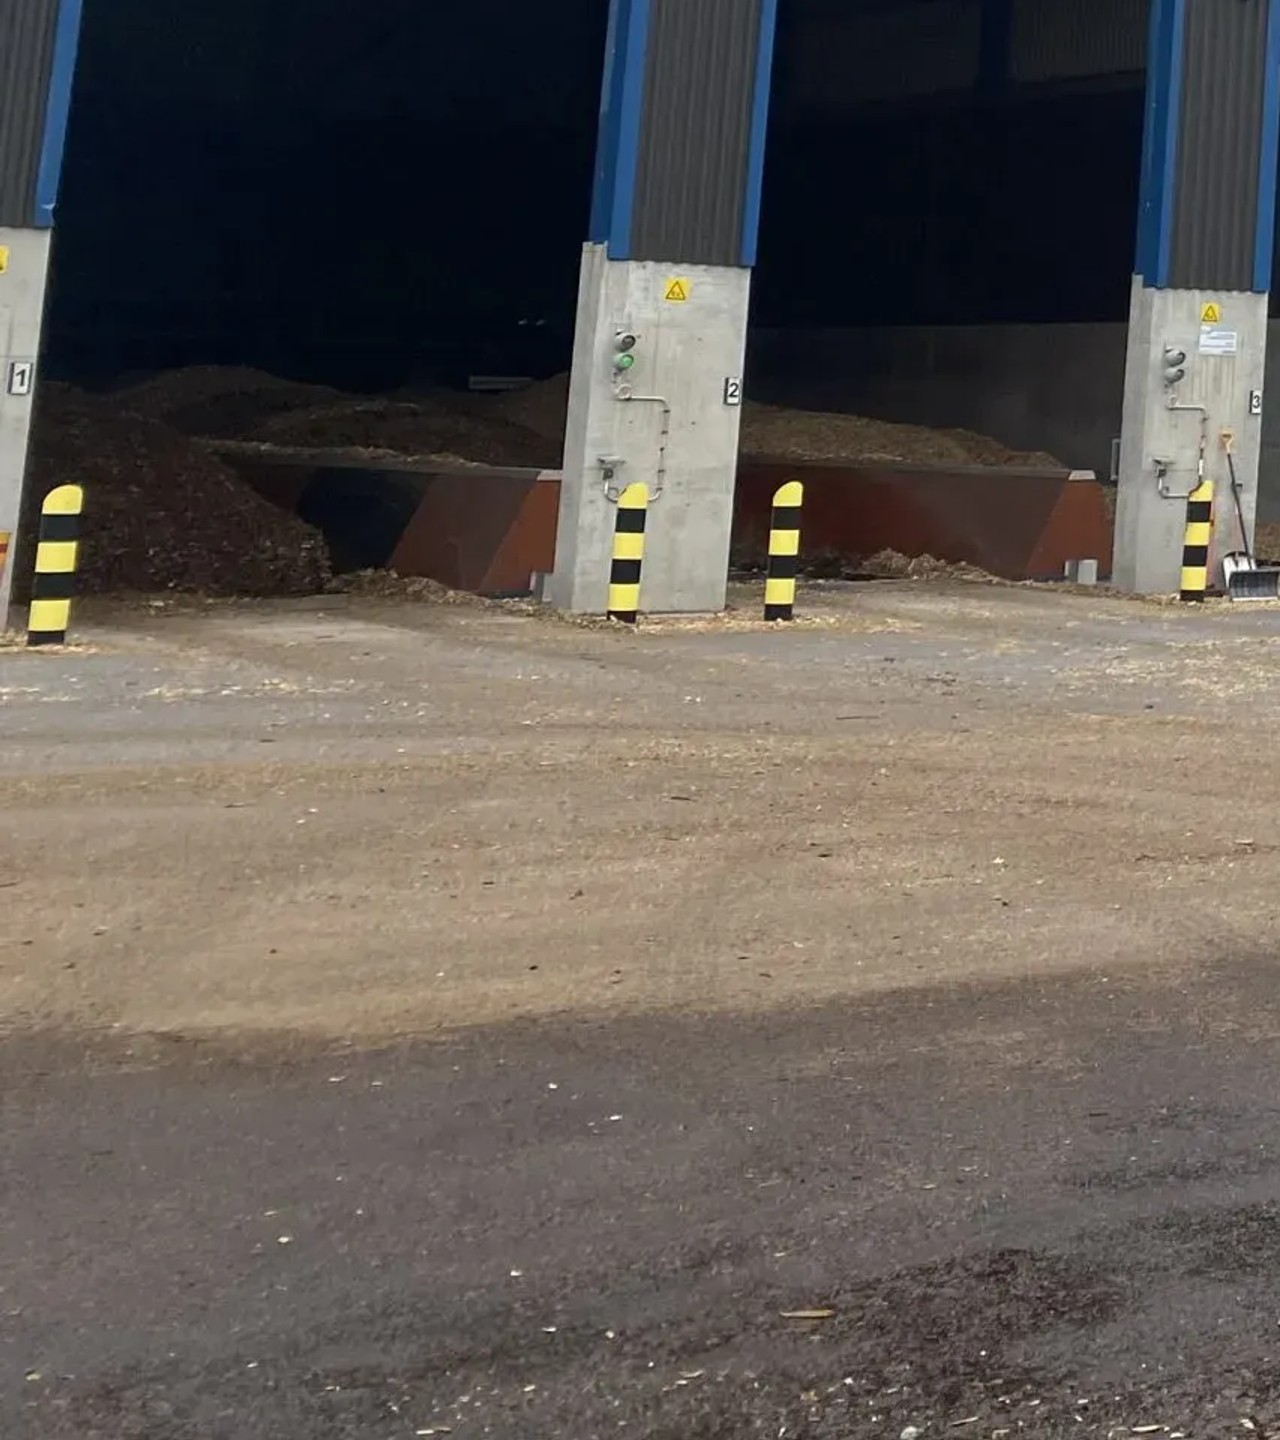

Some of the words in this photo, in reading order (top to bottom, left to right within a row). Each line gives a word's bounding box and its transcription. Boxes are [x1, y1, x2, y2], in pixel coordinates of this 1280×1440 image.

[15, 369, 26, 386] 1
[729, 382, 739, 397] 2
[1252, 394, 1261, 409] 3
